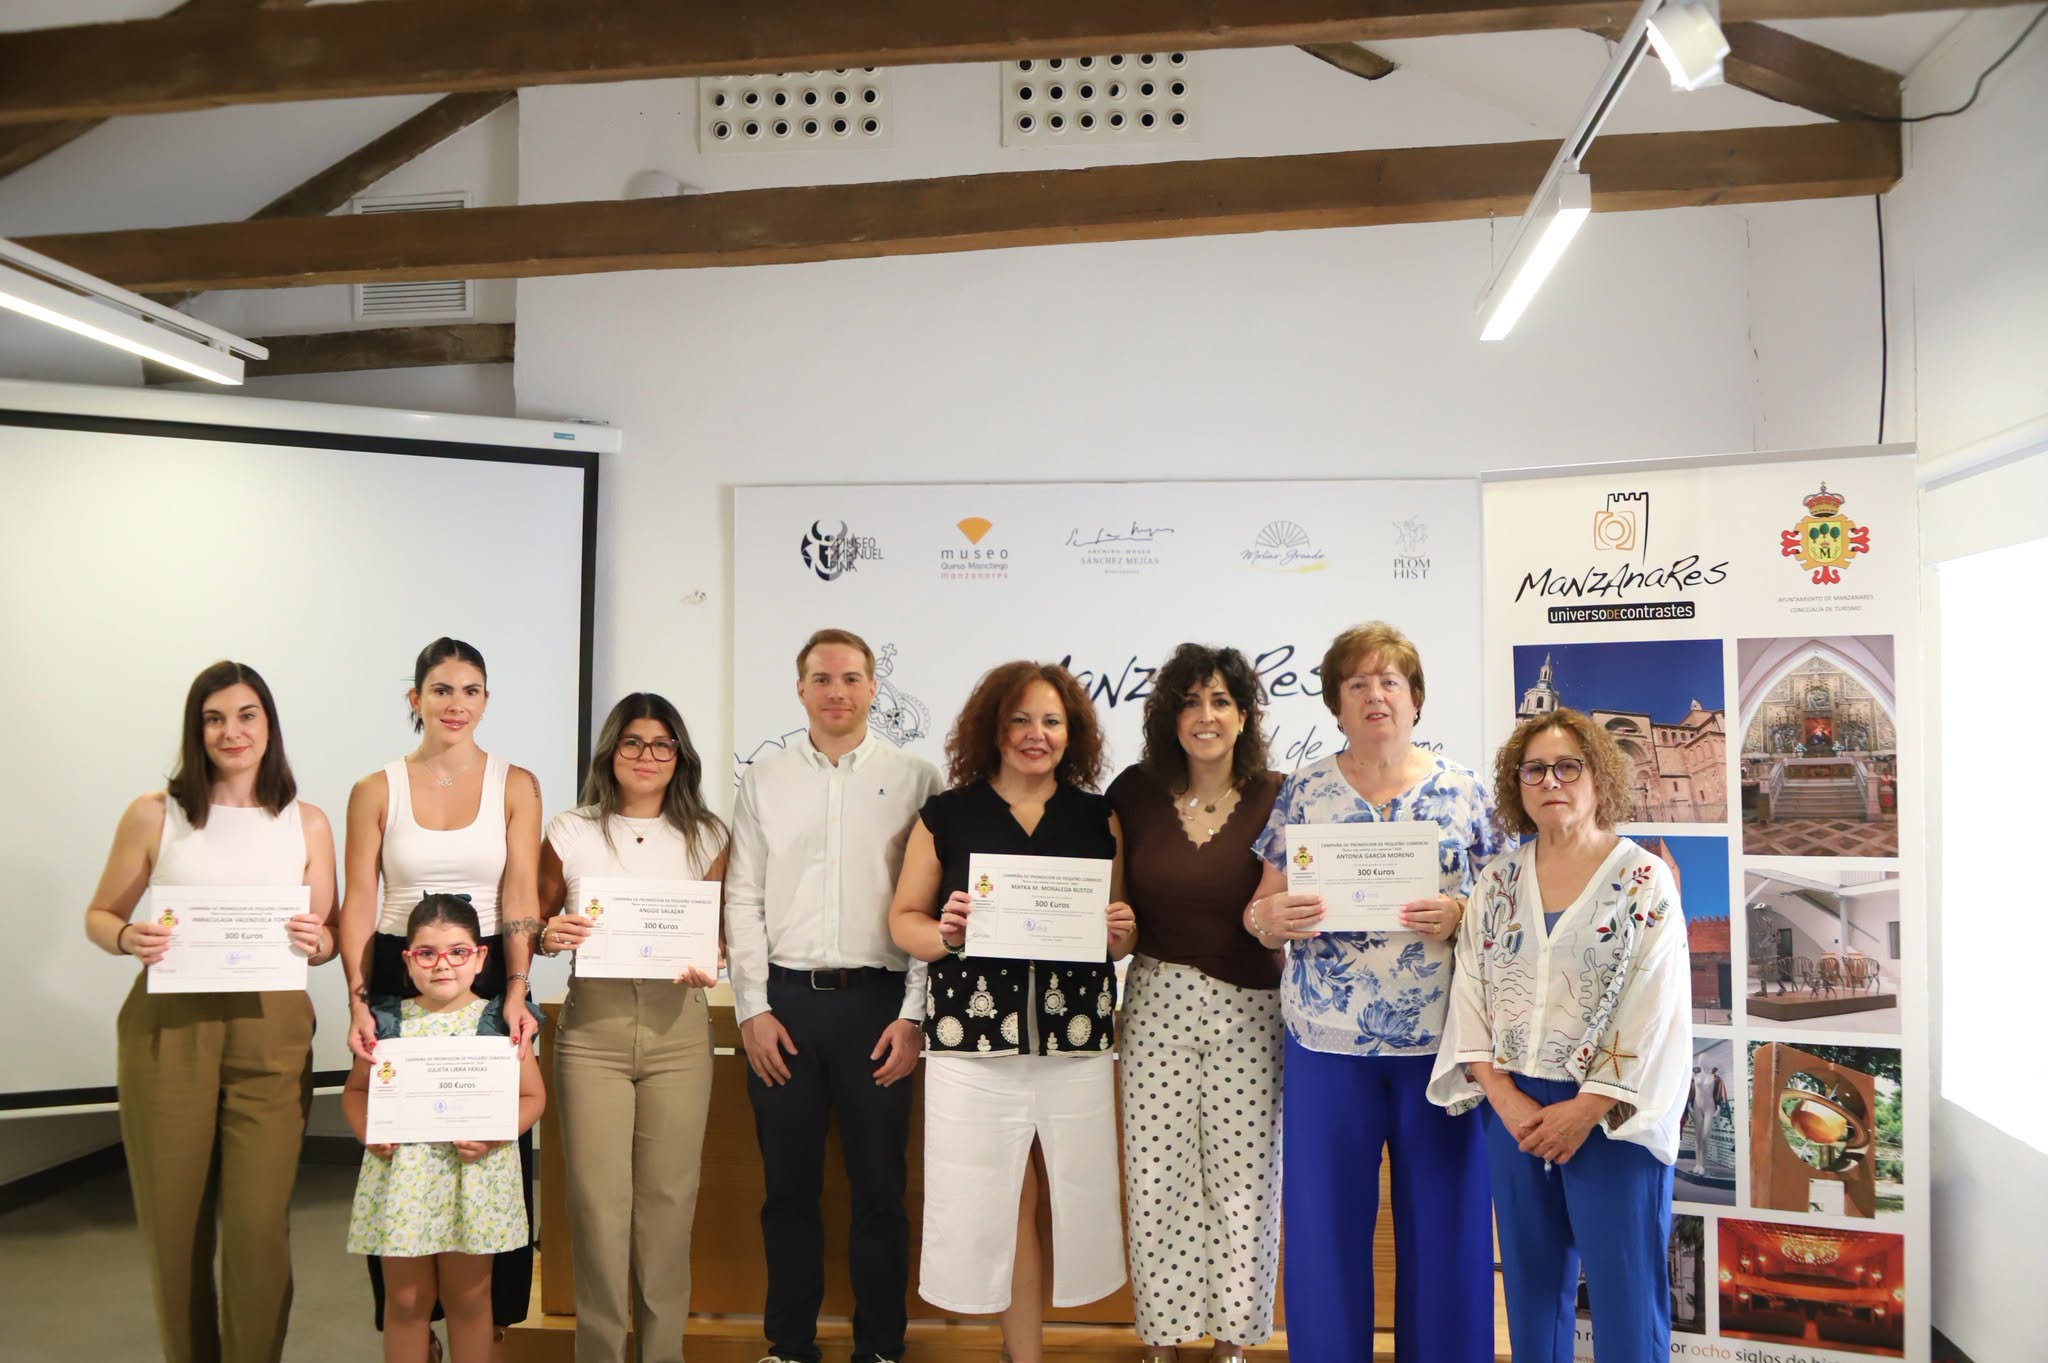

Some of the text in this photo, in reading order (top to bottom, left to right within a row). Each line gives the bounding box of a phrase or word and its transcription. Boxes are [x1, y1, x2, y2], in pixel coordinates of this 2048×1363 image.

[830, 537, 876, 549] MUSEO
[830, 549, 885, 560] MANUEL
[941, 549, 1008, 559] museo
[1394, 559, 1430, 568] PLOM
[1394, 569, 1429, 579] HIST
[1286, 725, 1322, 769] de
[1358, 868, 1371, 876] 300
[1041, 885, 1072, 893] MORALEDA
[224, 932, 239, 940] 300
[439, 1081, 452, 1089] 300
[1670, 1342, 1687, 1354] or
[1691, 1344, 1731, 1359] ocho
[1736, 1348, 1782, 1363] siglos
